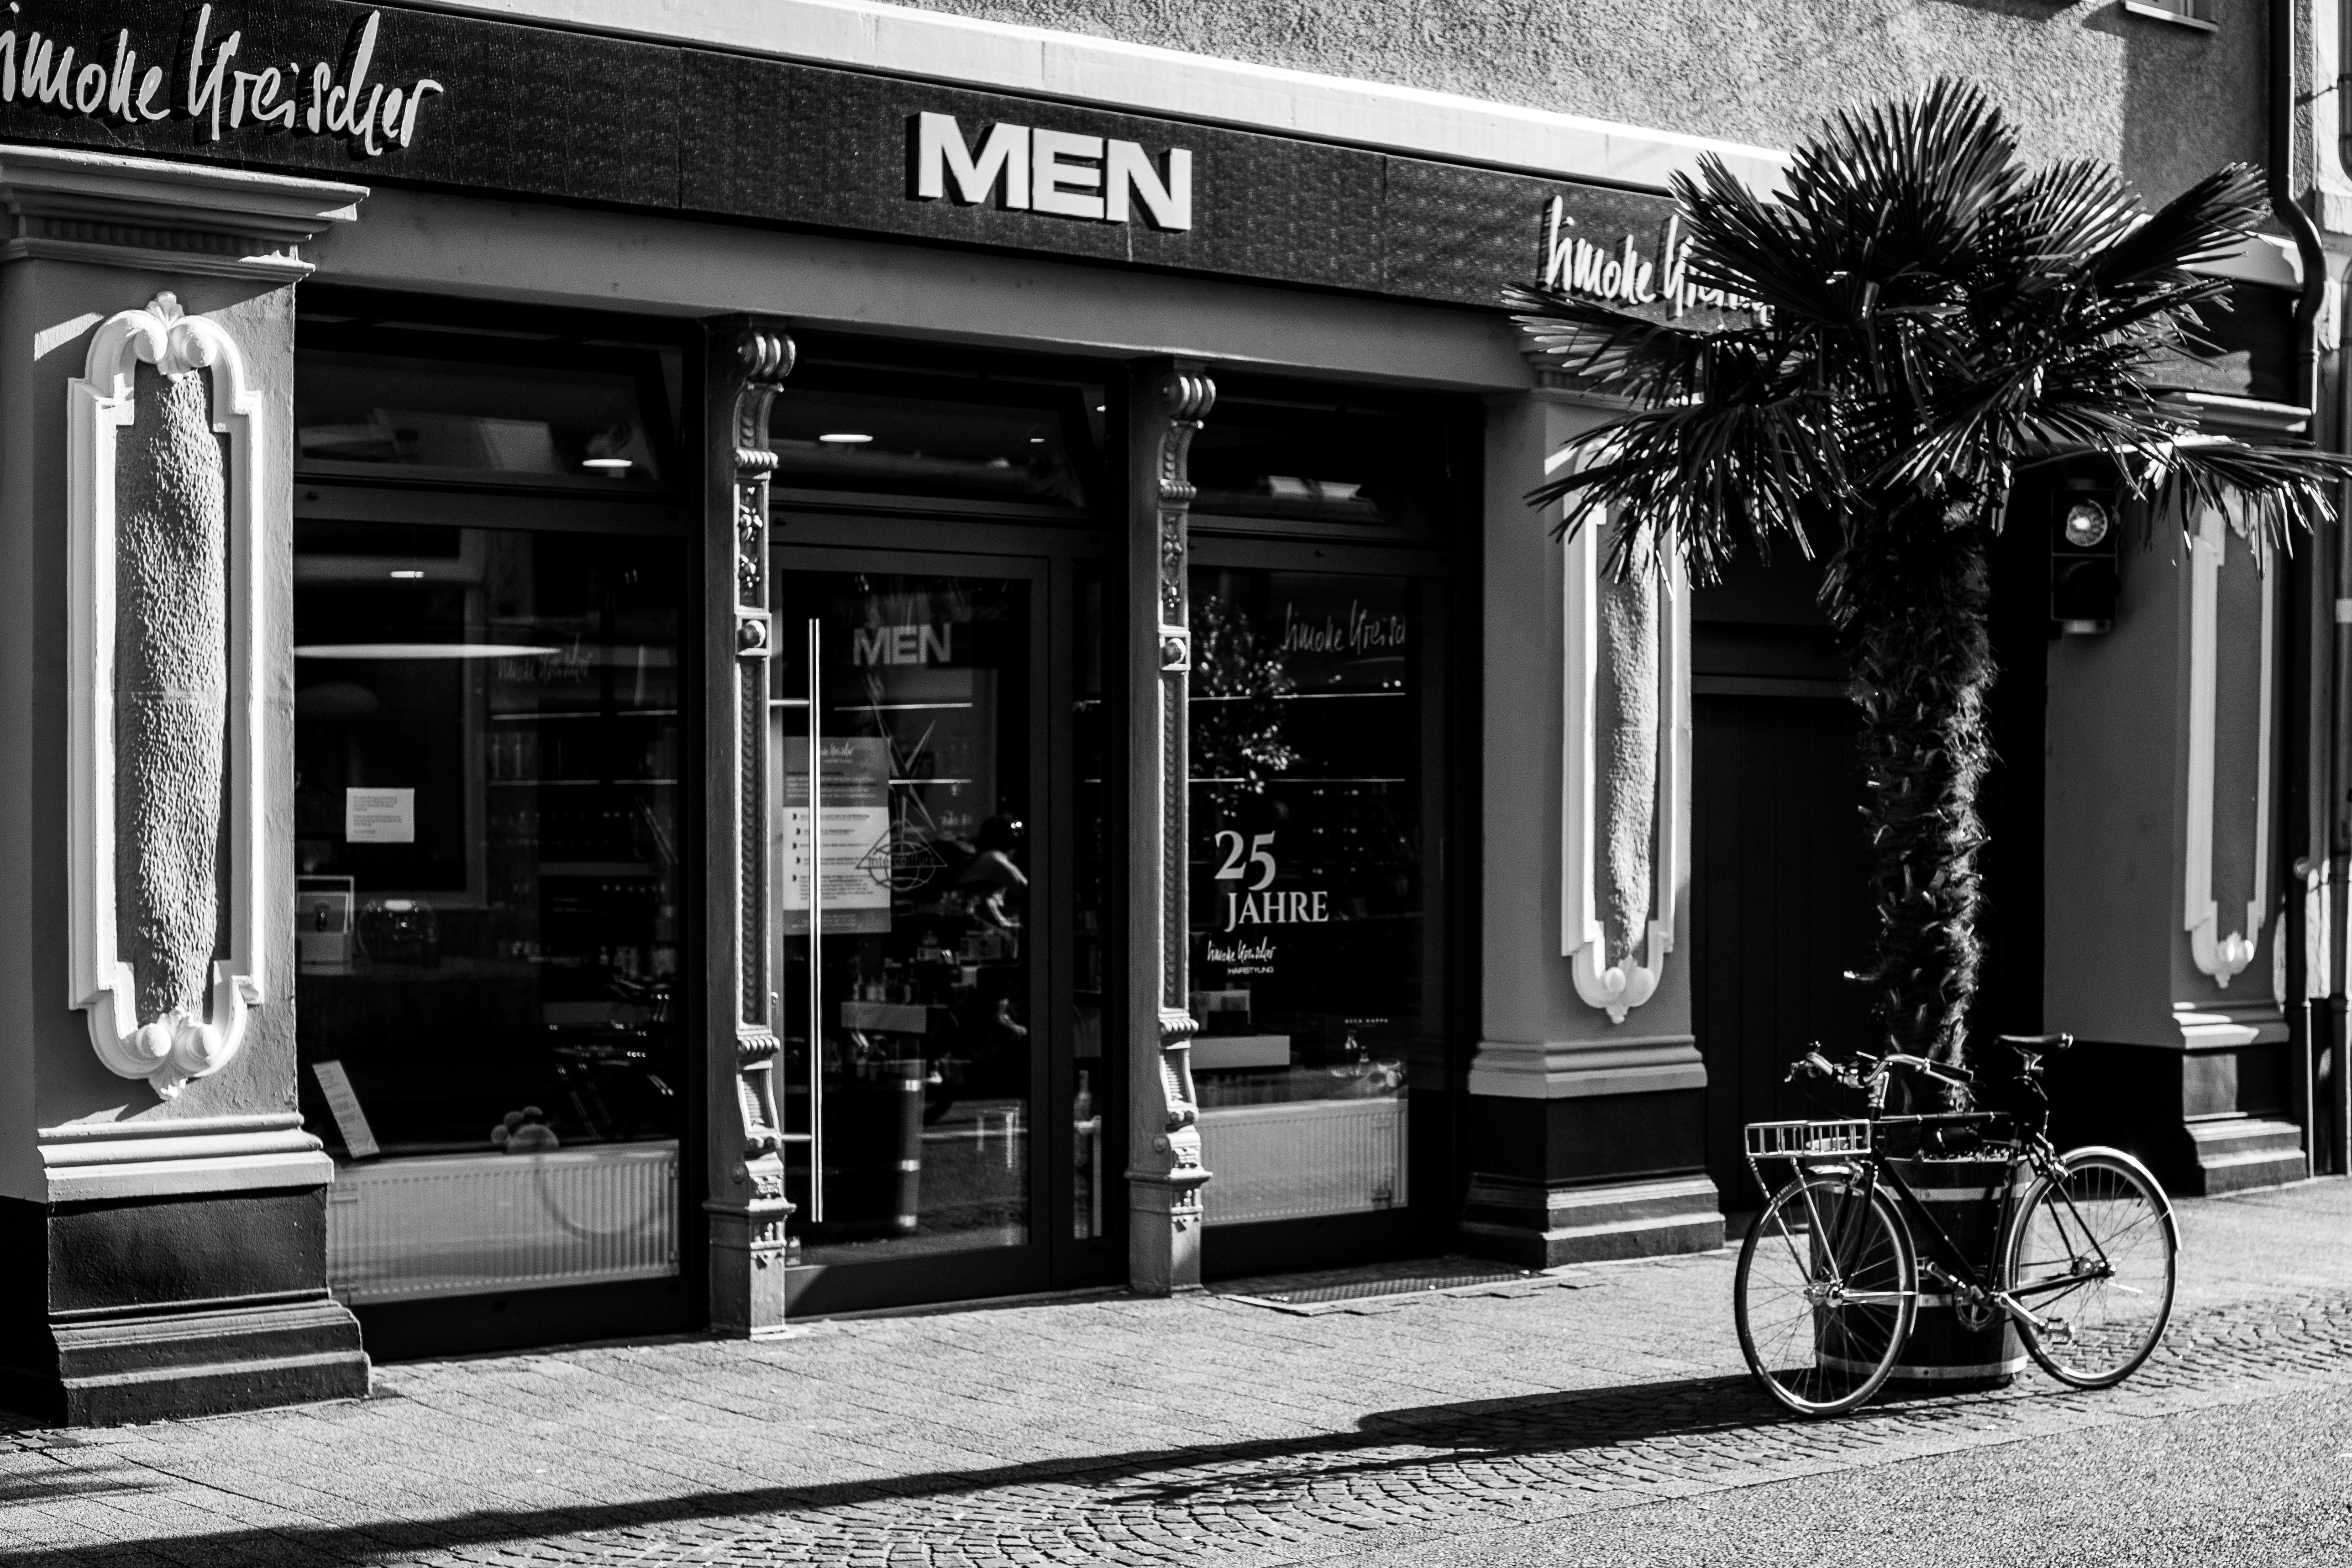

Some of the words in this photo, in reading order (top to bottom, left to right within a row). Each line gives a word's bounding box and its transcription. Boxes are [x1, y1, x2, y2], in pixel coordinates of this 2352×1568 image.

[918, 111, 1192, 231] MEN
[853, 622, 951, 666] MEN
[868, 855, 935, 866] intecoiffure
[1214, 829, 1277, 892] 25
[1223, 891, 1329, 933] JAHRE
